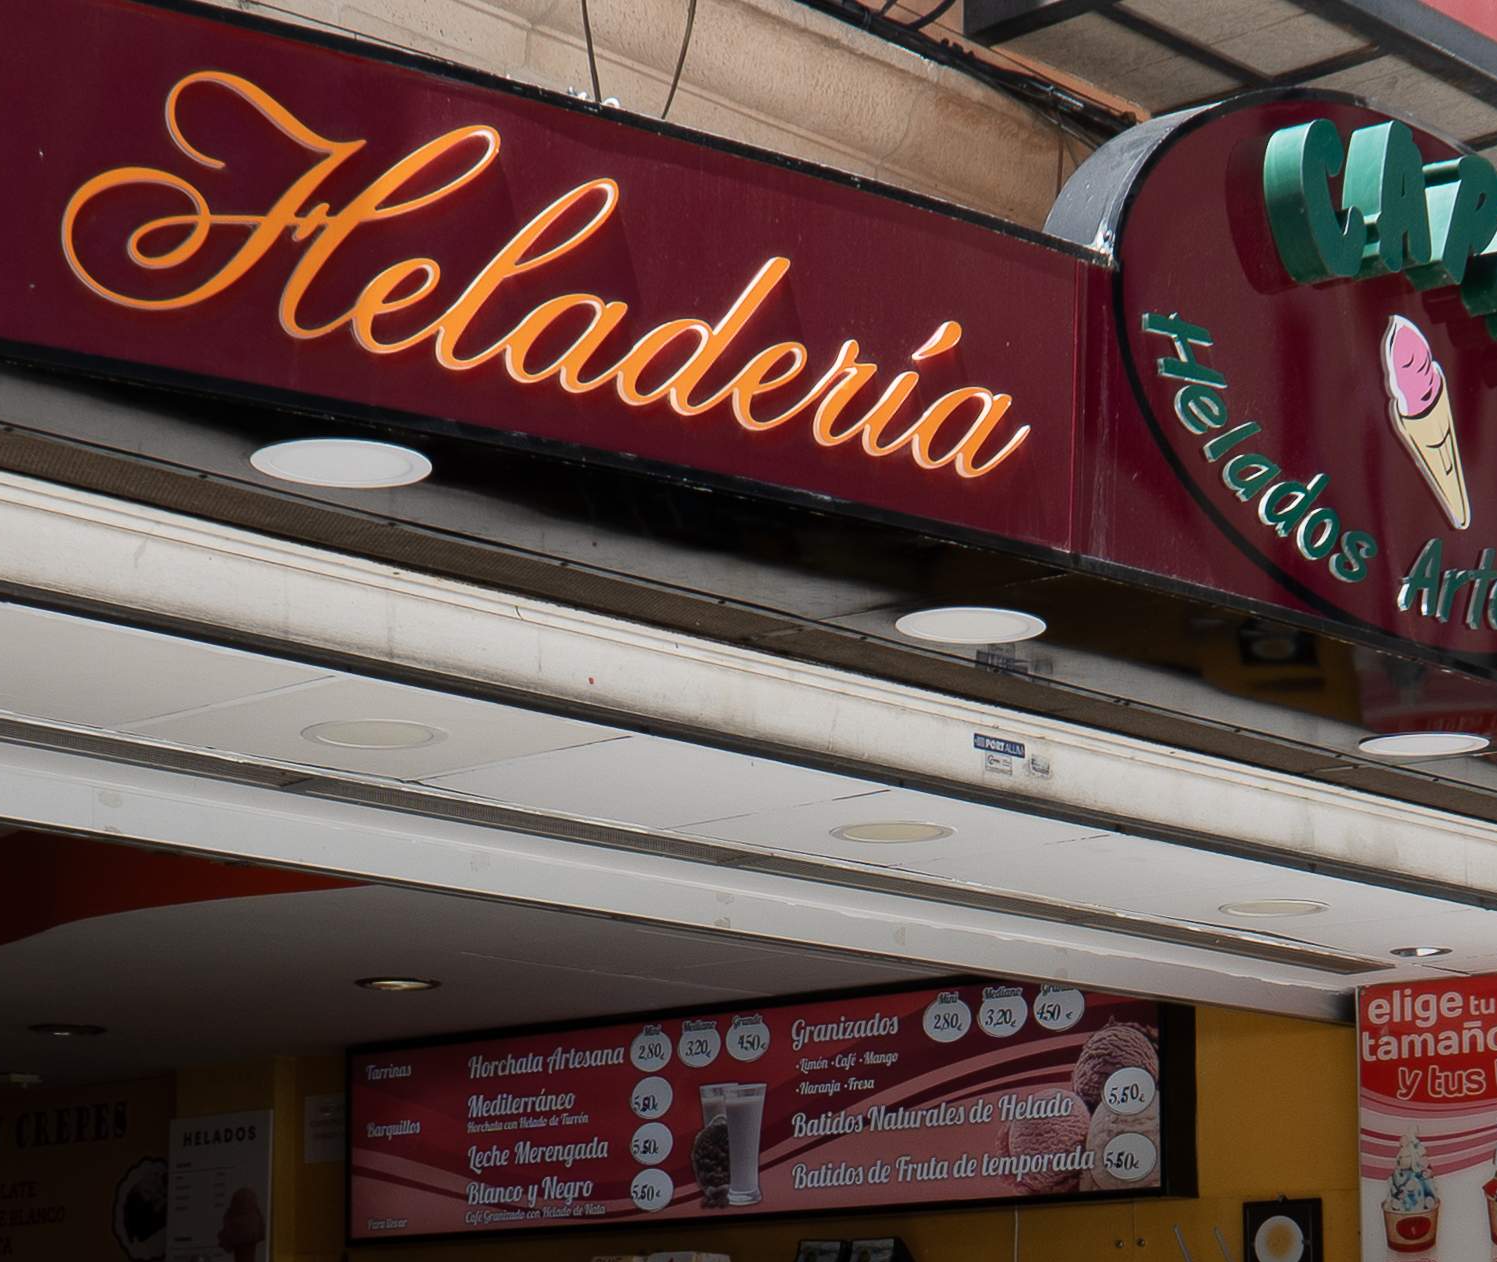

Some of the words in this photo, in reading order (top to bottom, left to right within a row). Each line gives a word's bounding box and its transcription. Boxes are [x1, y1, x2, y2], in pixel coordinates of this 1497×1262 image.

[61, 70, 1031, 478] Heladería
[1140, 311, 1378, 583] Helados
[1368, 990, 1464, 1028] elige
[1470, 995, 1496, 1016] tu
[791, 1012, 900, 1050] Granizados
[365, 1063, 412, 1081] Tarrinas
[466, 1052, 545, 1080] Horchata
[547, 1044, 625, 1074] Artesana
[1397, 1067, 1422, 1100] y
[1427, 1065, 1486, 1097] tus
[467, 1088, 576, 1118] Mediterráneo
[791, 1111, 863, 1139] Batidos
[867, 1103, 966, 1132] Naturales
[969, 1098, 993, 1123] de
[998, 1092, 1074, 1122] Helado
[16, 1100, 129, 1150] CREPES
[183, 1126, 257, 1147] HELADOS
[365, 1120, 421, 1140] Barquillos
[467, 1145, 510, 1175] Leche
[514, 1136, 608, 1168] Merengada
[791, 1161, 864, 1190] Batidos
[867, 1157, 891, 1184] de
[895, 1155, 949, 1184] Fruta
[953, 1152, 978, 1178] de
[981, 1146, 1096, 1182] temporada
[466, 1181, 523, 1206] Blanco
[527, 1183, 538, 1208] y
[541, 1175, 593, 1206] Negro
